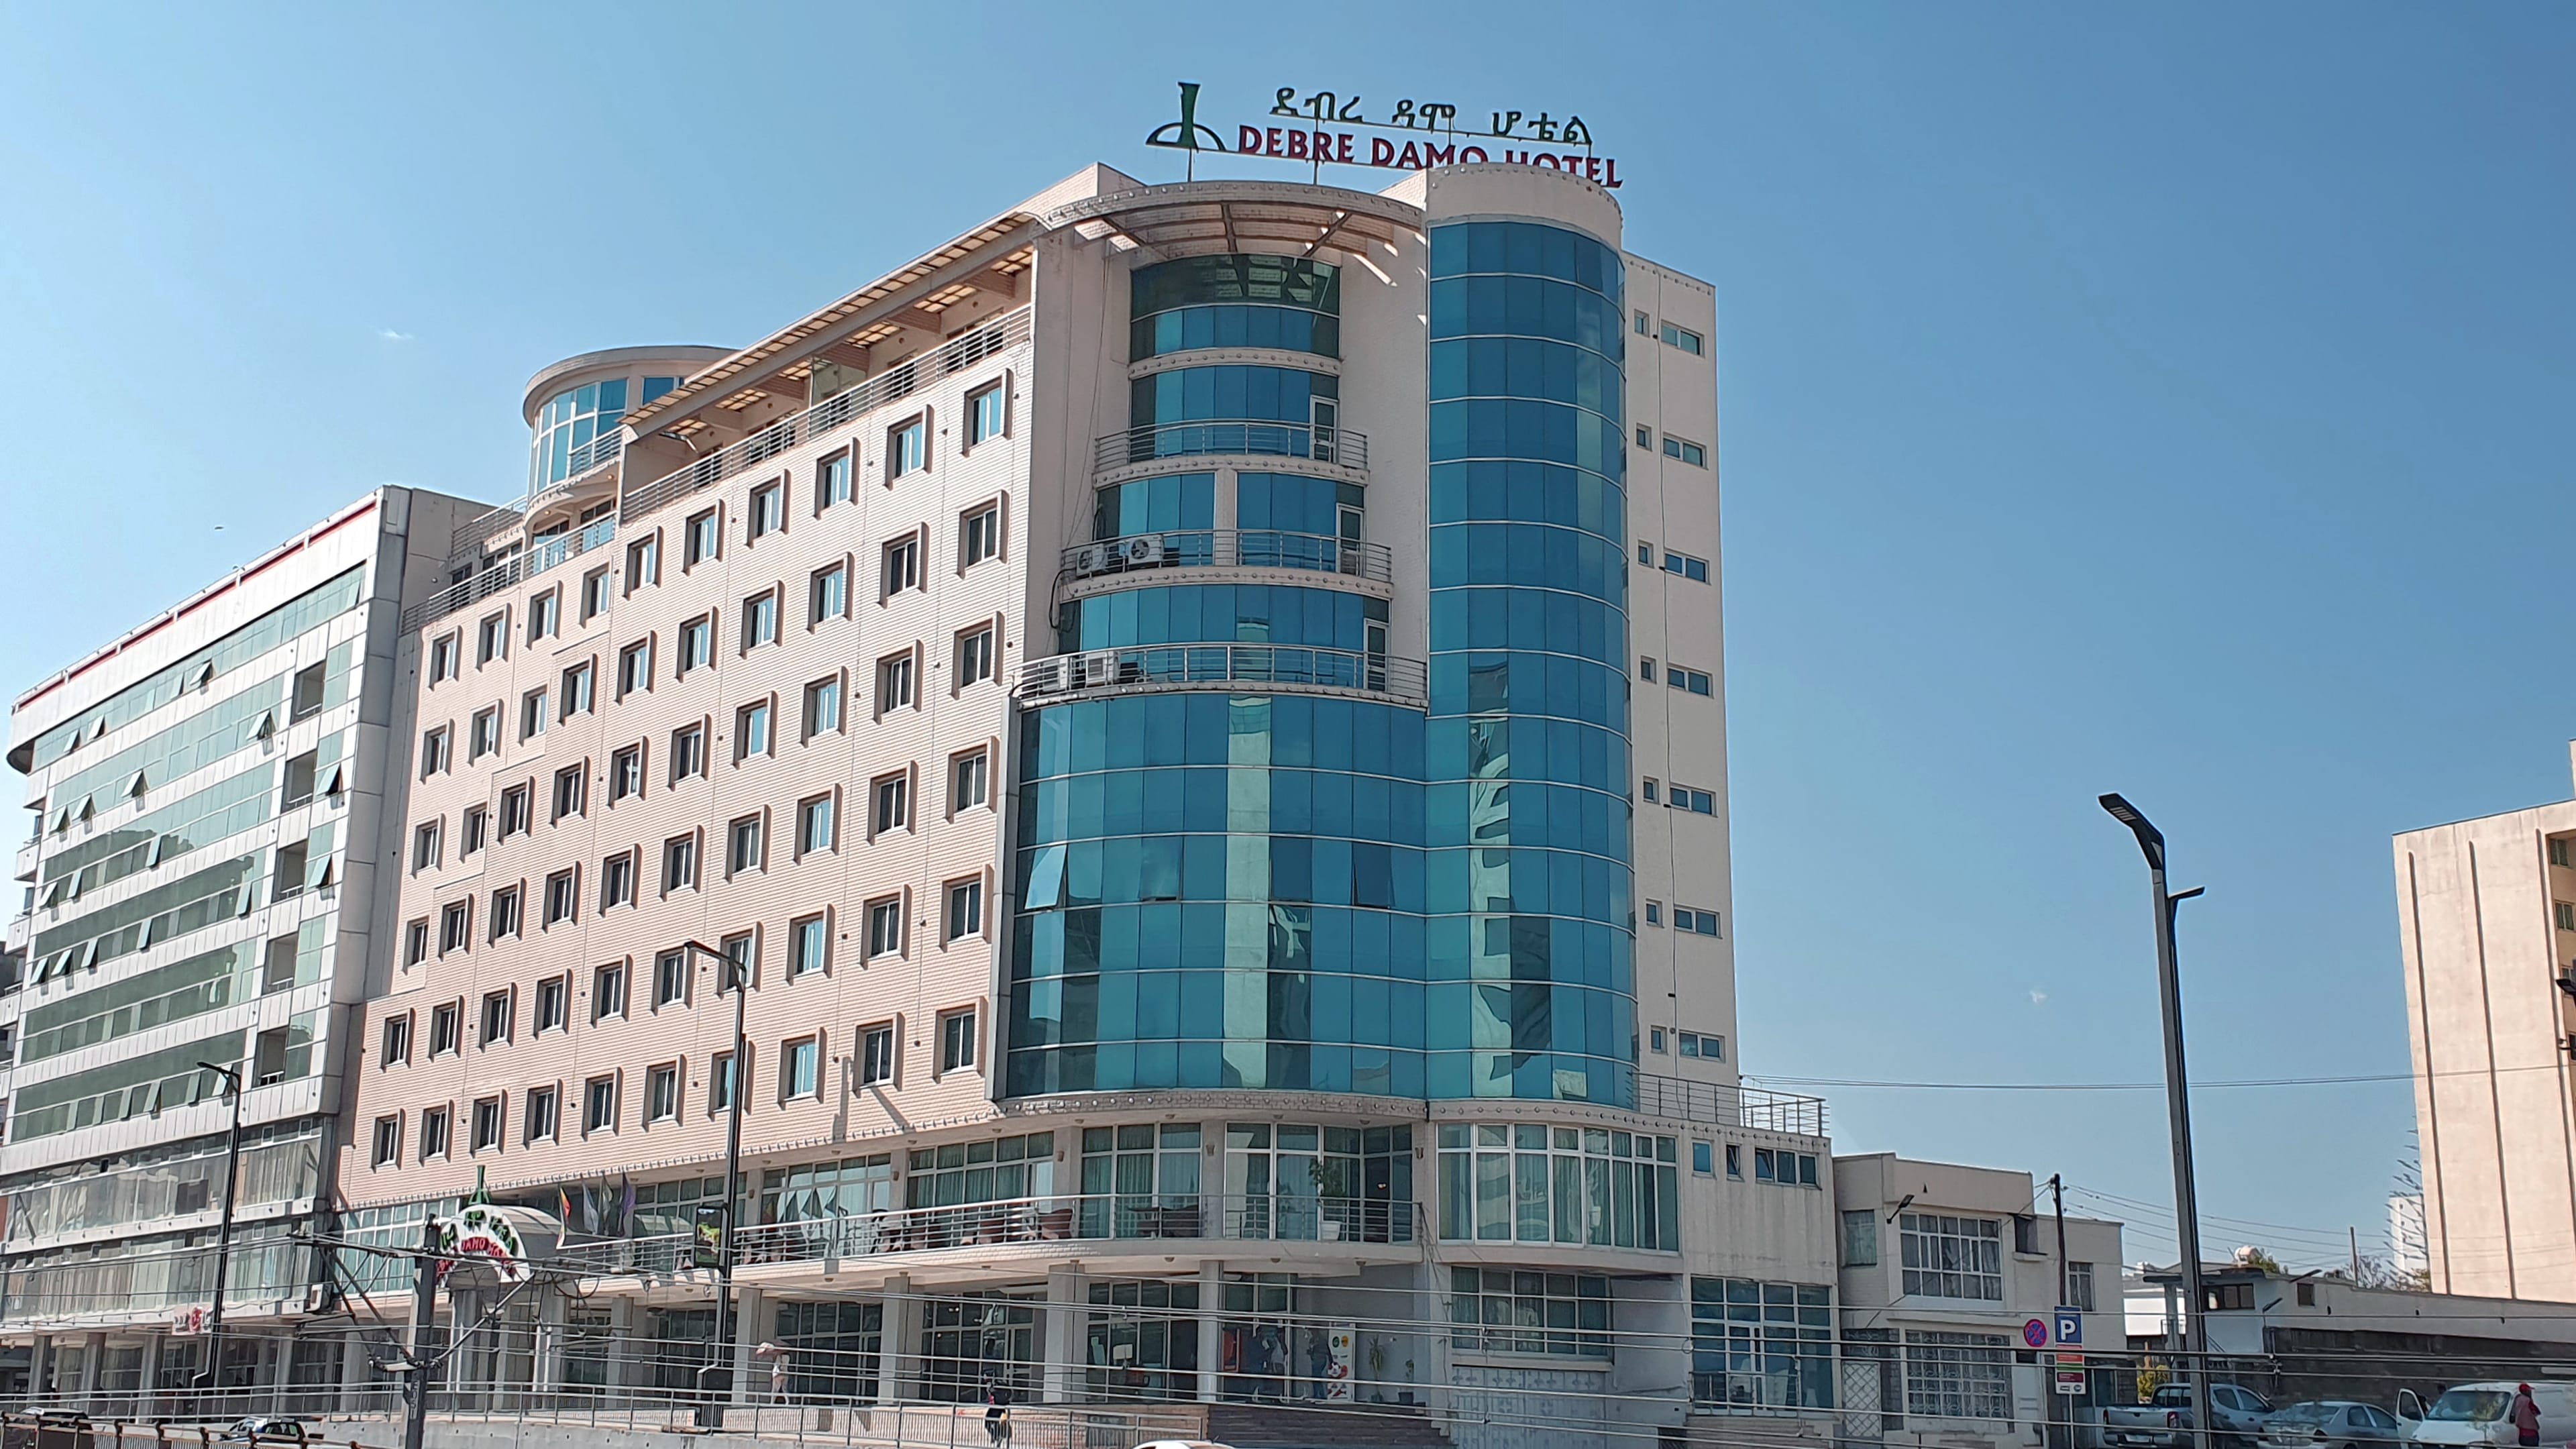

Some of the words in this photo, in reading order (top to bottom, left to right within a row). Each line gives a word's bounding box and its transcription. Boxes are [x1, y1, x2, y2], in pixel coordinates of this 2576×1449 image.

[1269, 87, 1362, 123] ደብረ
[1391, 99, 1456, 130] ዳሞ
[1492, 111, 1592, 144] ሆቴል
[1239, 125, 1355, 163] DEBRE
[1372, 137, 1489, 170] DAMO
[1505, 150, 1623, 188] HOTEL
[2060, 1319, 2076, 1341] P
